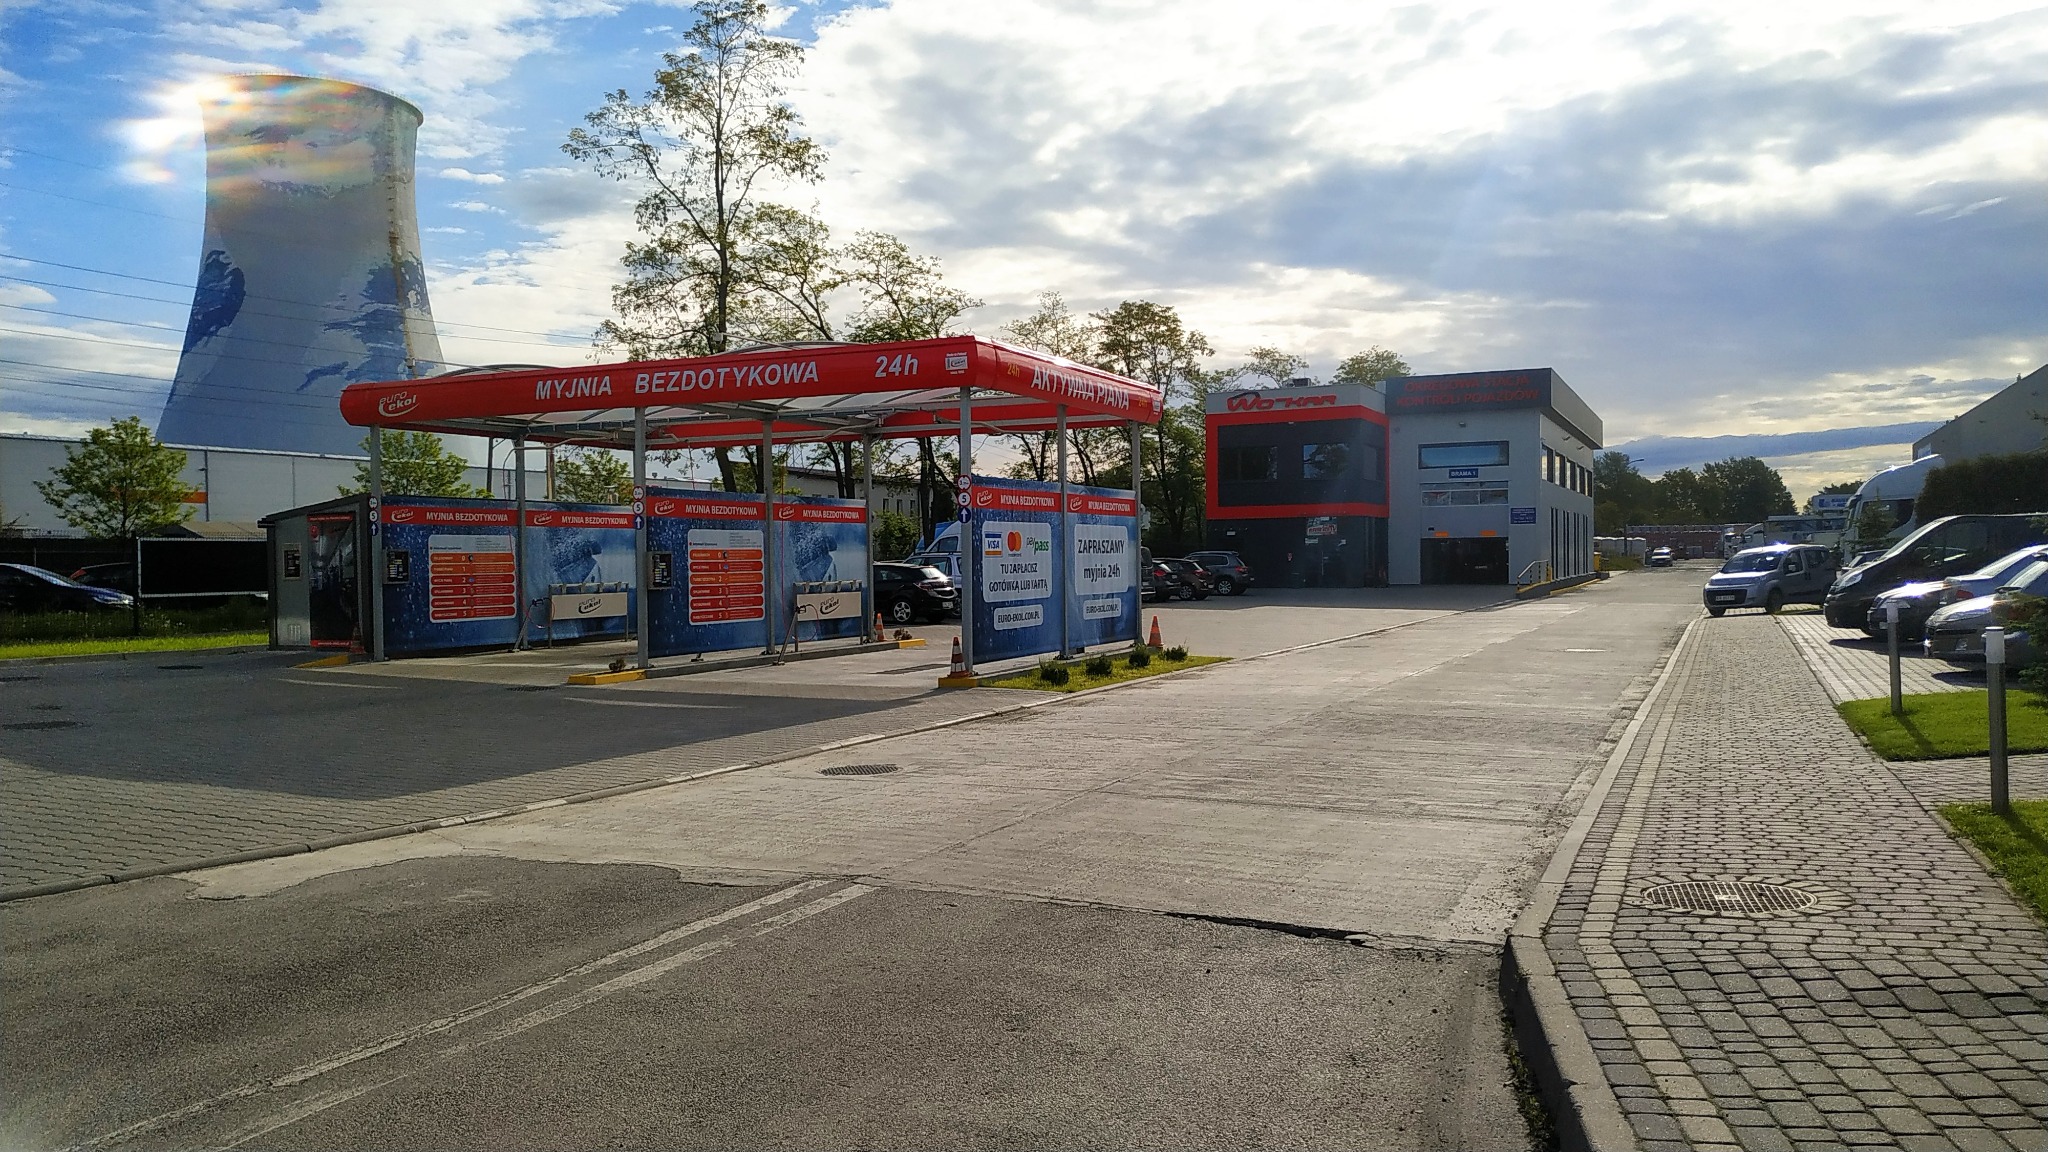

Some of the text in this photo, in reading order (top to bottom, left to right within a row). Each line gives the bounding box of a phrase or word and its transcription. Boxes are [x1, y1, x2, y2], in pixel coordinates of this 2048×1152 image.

[535, 354, 919, 400] MYJNIA BEZDOTYKOWA 24h
[1007, 363, 1020, 377] 24h
[1031, 366, 1095, 402] AKTYWNA
[1096, 383, 1129, 410] PIANA
[379, 391, 407, 405] euro
[388, 395, 416, 411] ekol
[961, 495, 967, 503] 5
[1000, 494, 1055, 507] MYJNIA BEZDOTYKOWA
[371, 512, 376, 520] 5
[685, 504, 758, 516] MYJNIA BEZDOTYKOWA
[803, 509, 859, 520] MYJNIA BEZDOTYKOWA
[426, 511, 509, 522] MYJNIA BEZDOTYKOWA
[562, 515, 628, 525] MYJNIA BEZDOTYKOWA
[987, 540, 1000, 549] VISA
[1078, 539, 1125, 554] ZAPRASZAMY
[1000, 563, 1038, 574] TU ZAPŁACISZ
[1083, 562, 1121, 582] myjnia 24h
[989, 579, 1020, 593] GOTÓWKĄ
[1020, 580, 1031, 590] LUB
[825, 599, 839, 611] ekol
